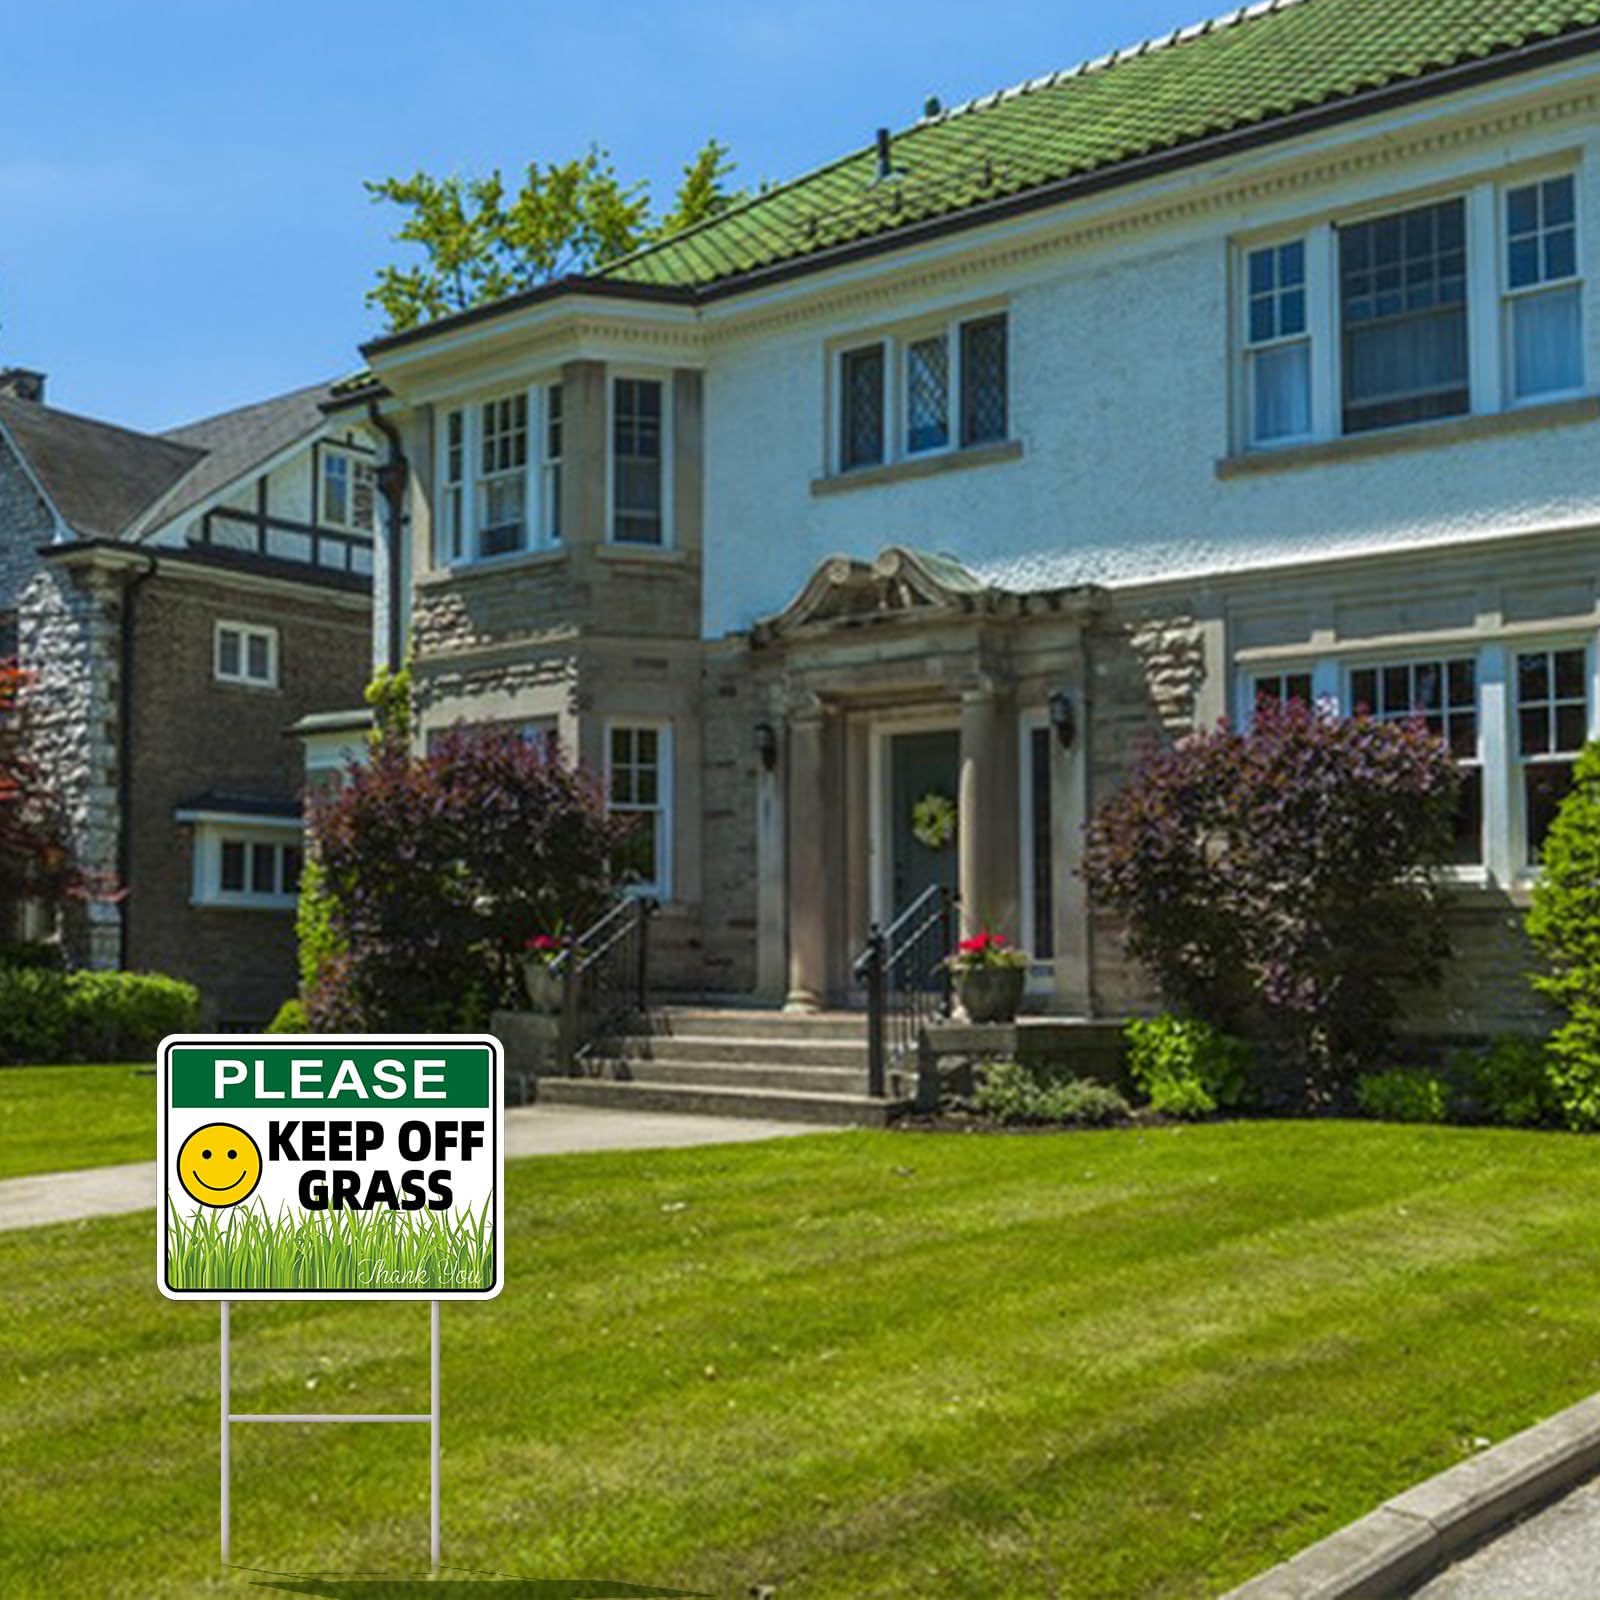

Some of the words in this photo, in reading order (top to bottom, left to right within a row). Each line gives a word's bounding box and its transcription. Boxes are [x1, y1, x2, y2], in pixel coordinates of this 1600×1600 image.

[214, 1059, 447, 1099] PLEASE
[268, 1120, 385, 1161] KEEP
[398, 1120, 485, 1161] OFF
[298, 1170, 454, 1211] GRASS
[358, 1258, 430, 1284] Thank
[437, 1258, 483, 1284] You
